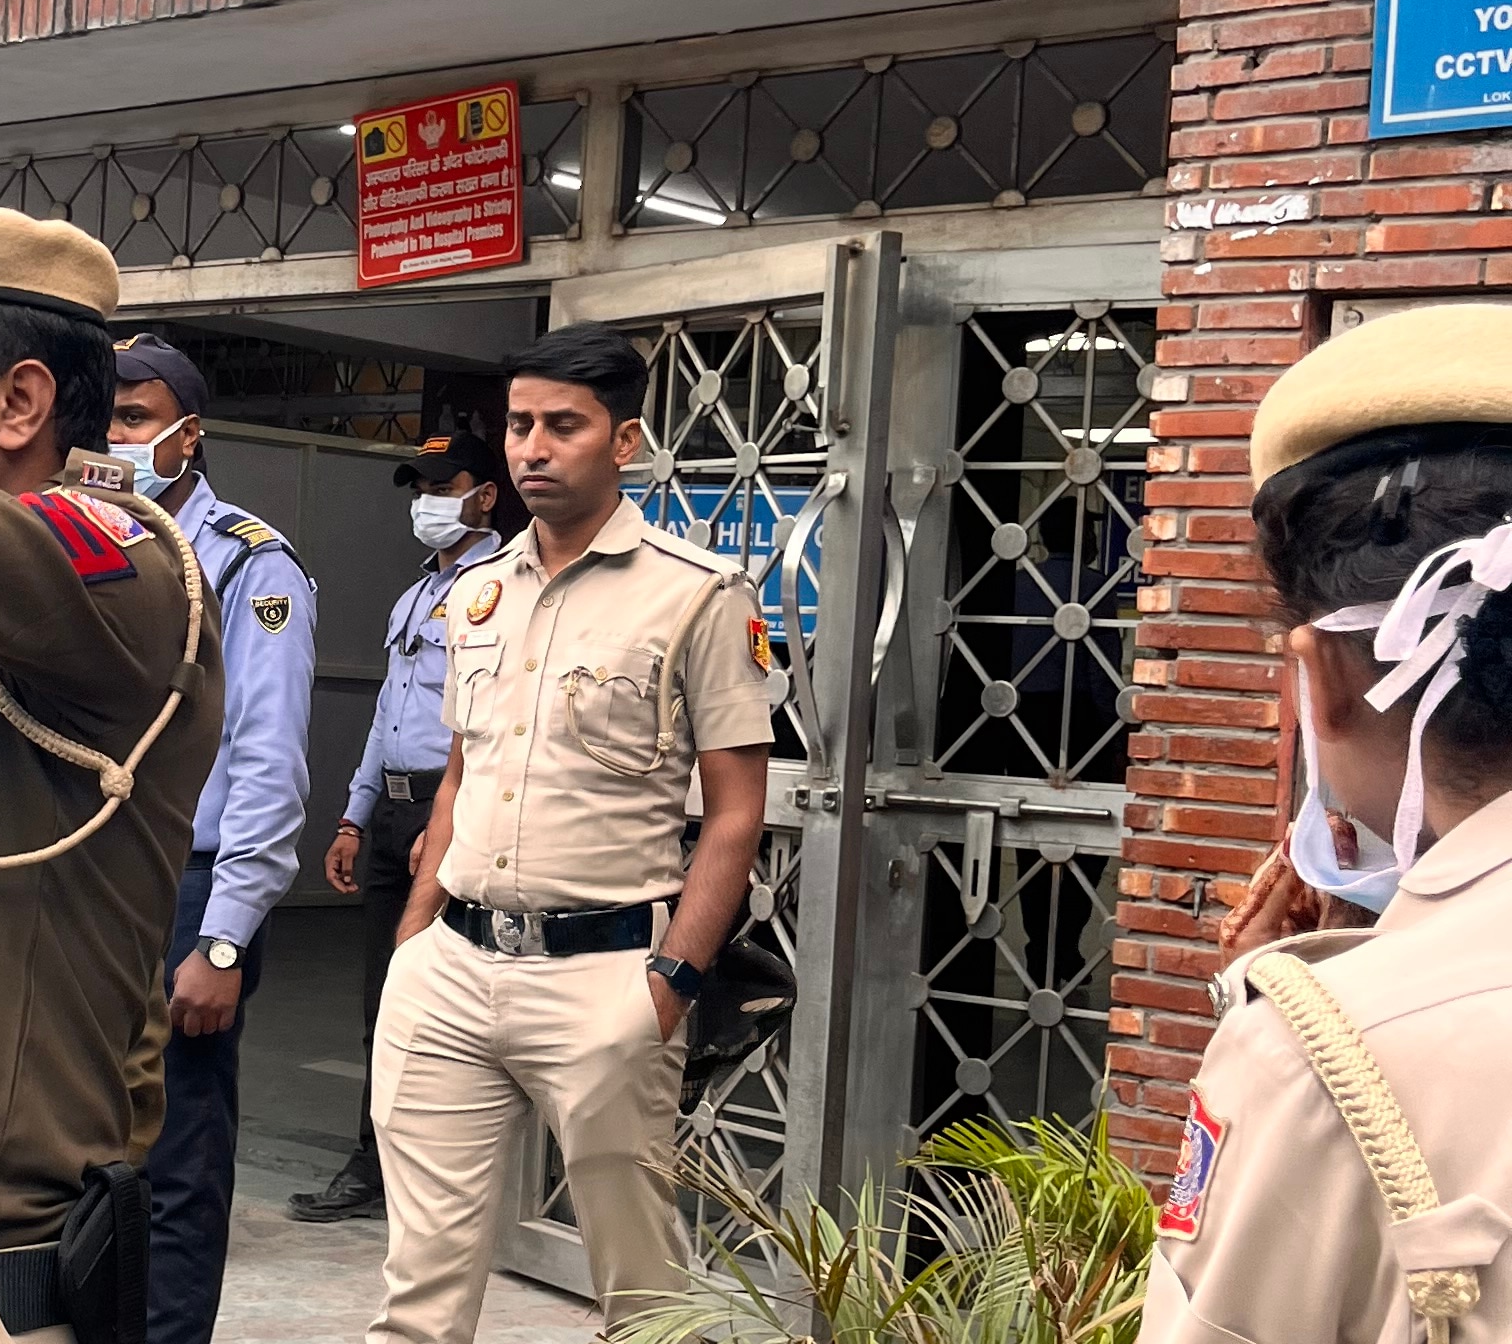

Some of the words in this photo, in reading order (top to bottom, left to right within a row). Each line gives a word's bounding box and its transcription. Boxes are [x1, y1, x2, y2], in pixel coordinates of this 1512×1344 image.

[1435, 47, 1512, 80] CCTV
[1483, 91, 1512, 104] LOK
[717, 521, 777, 547] HEL
